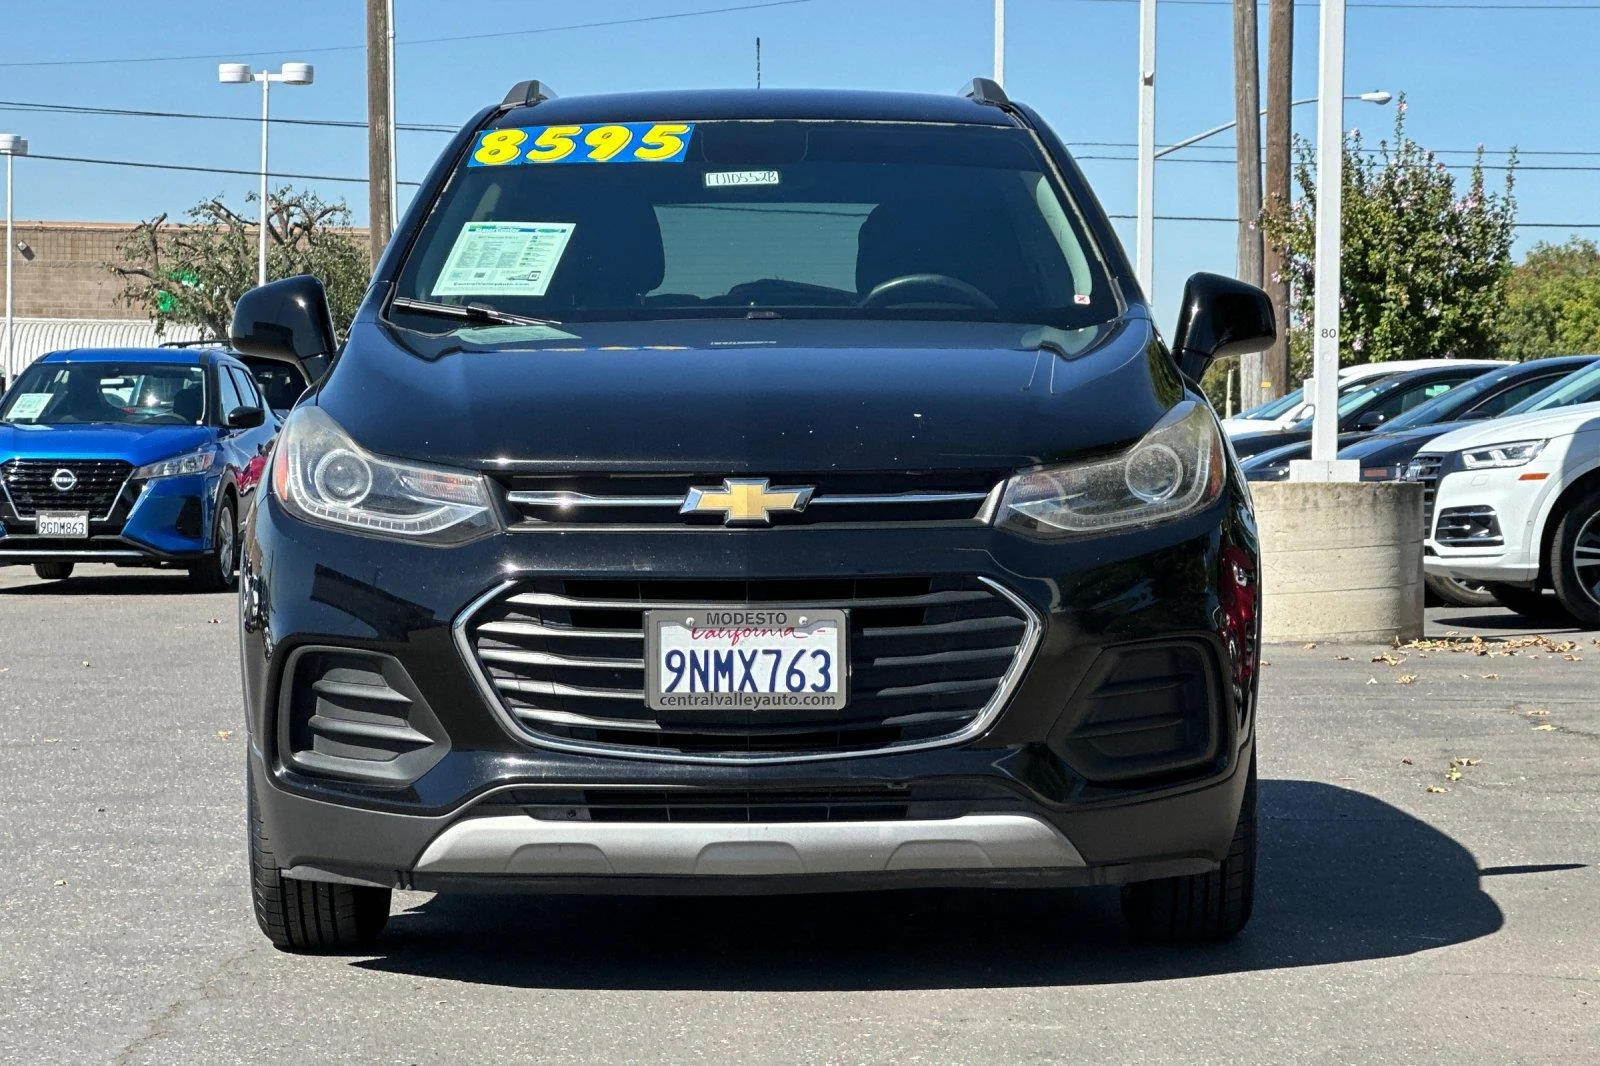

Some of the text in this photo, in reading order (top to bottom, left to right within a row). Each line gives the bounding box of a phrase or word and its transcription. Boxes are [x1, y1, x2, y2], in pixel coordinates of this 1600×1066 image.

[474, 124, 691, 165] 8595
[1321, 328, 1337, 339] 80
[40, 521, 85, 534] 9GDM863
[706, 612, 788, 625] MODESTO
[664, 648, 832, 693] 9NMX763
[659, 693, 836, 709] centralvalleyauto.com
